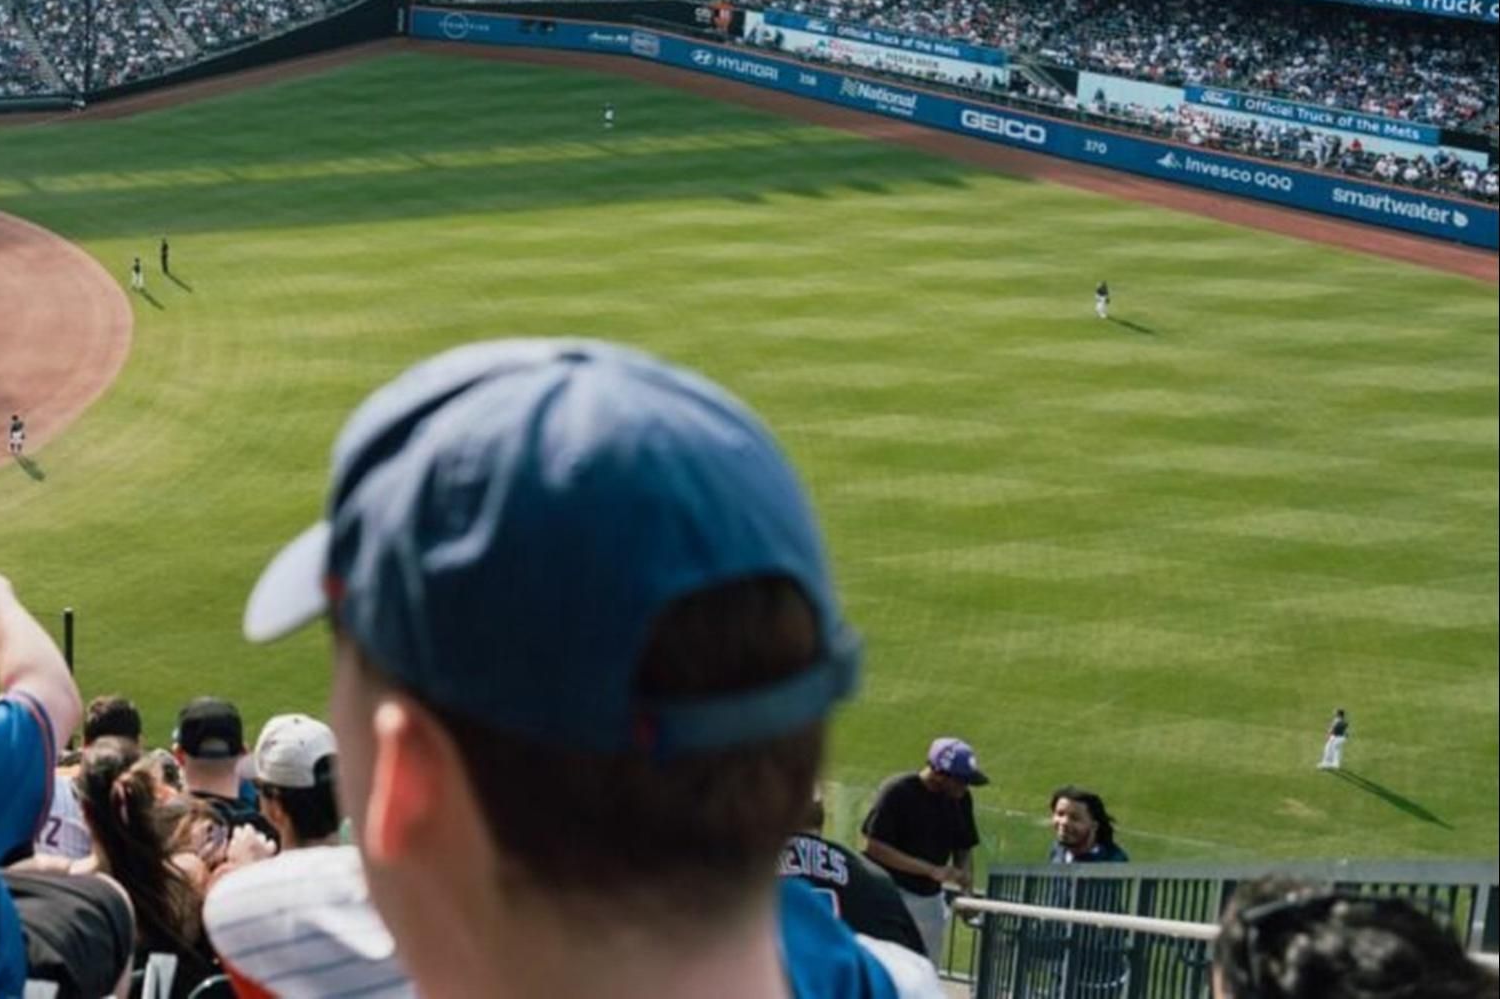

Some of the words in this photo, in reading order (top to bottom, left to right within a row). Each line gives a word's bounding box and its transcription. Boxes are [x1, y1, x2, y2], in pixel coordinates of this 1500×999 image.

[716, 55, 779, 81] HYUNDAI
[857, 83, 918, 109] National
[961, 109, 1046, 144] GEICO
[1245, 98, 1294, 120] Official
[1298, 107, 1334, 126] Truck
[1338, 114, 1353, 130] of
[1357, 116, 1380, 135] the
[1383, 122, 1421, 141] Mets
[1084, 139, 1108, 155] 370
[1185, 157, 1251, 183] Invesco
[1254, 171, 1293, 191] QQQ
[1332, 187, 1450, 224] smartwater
